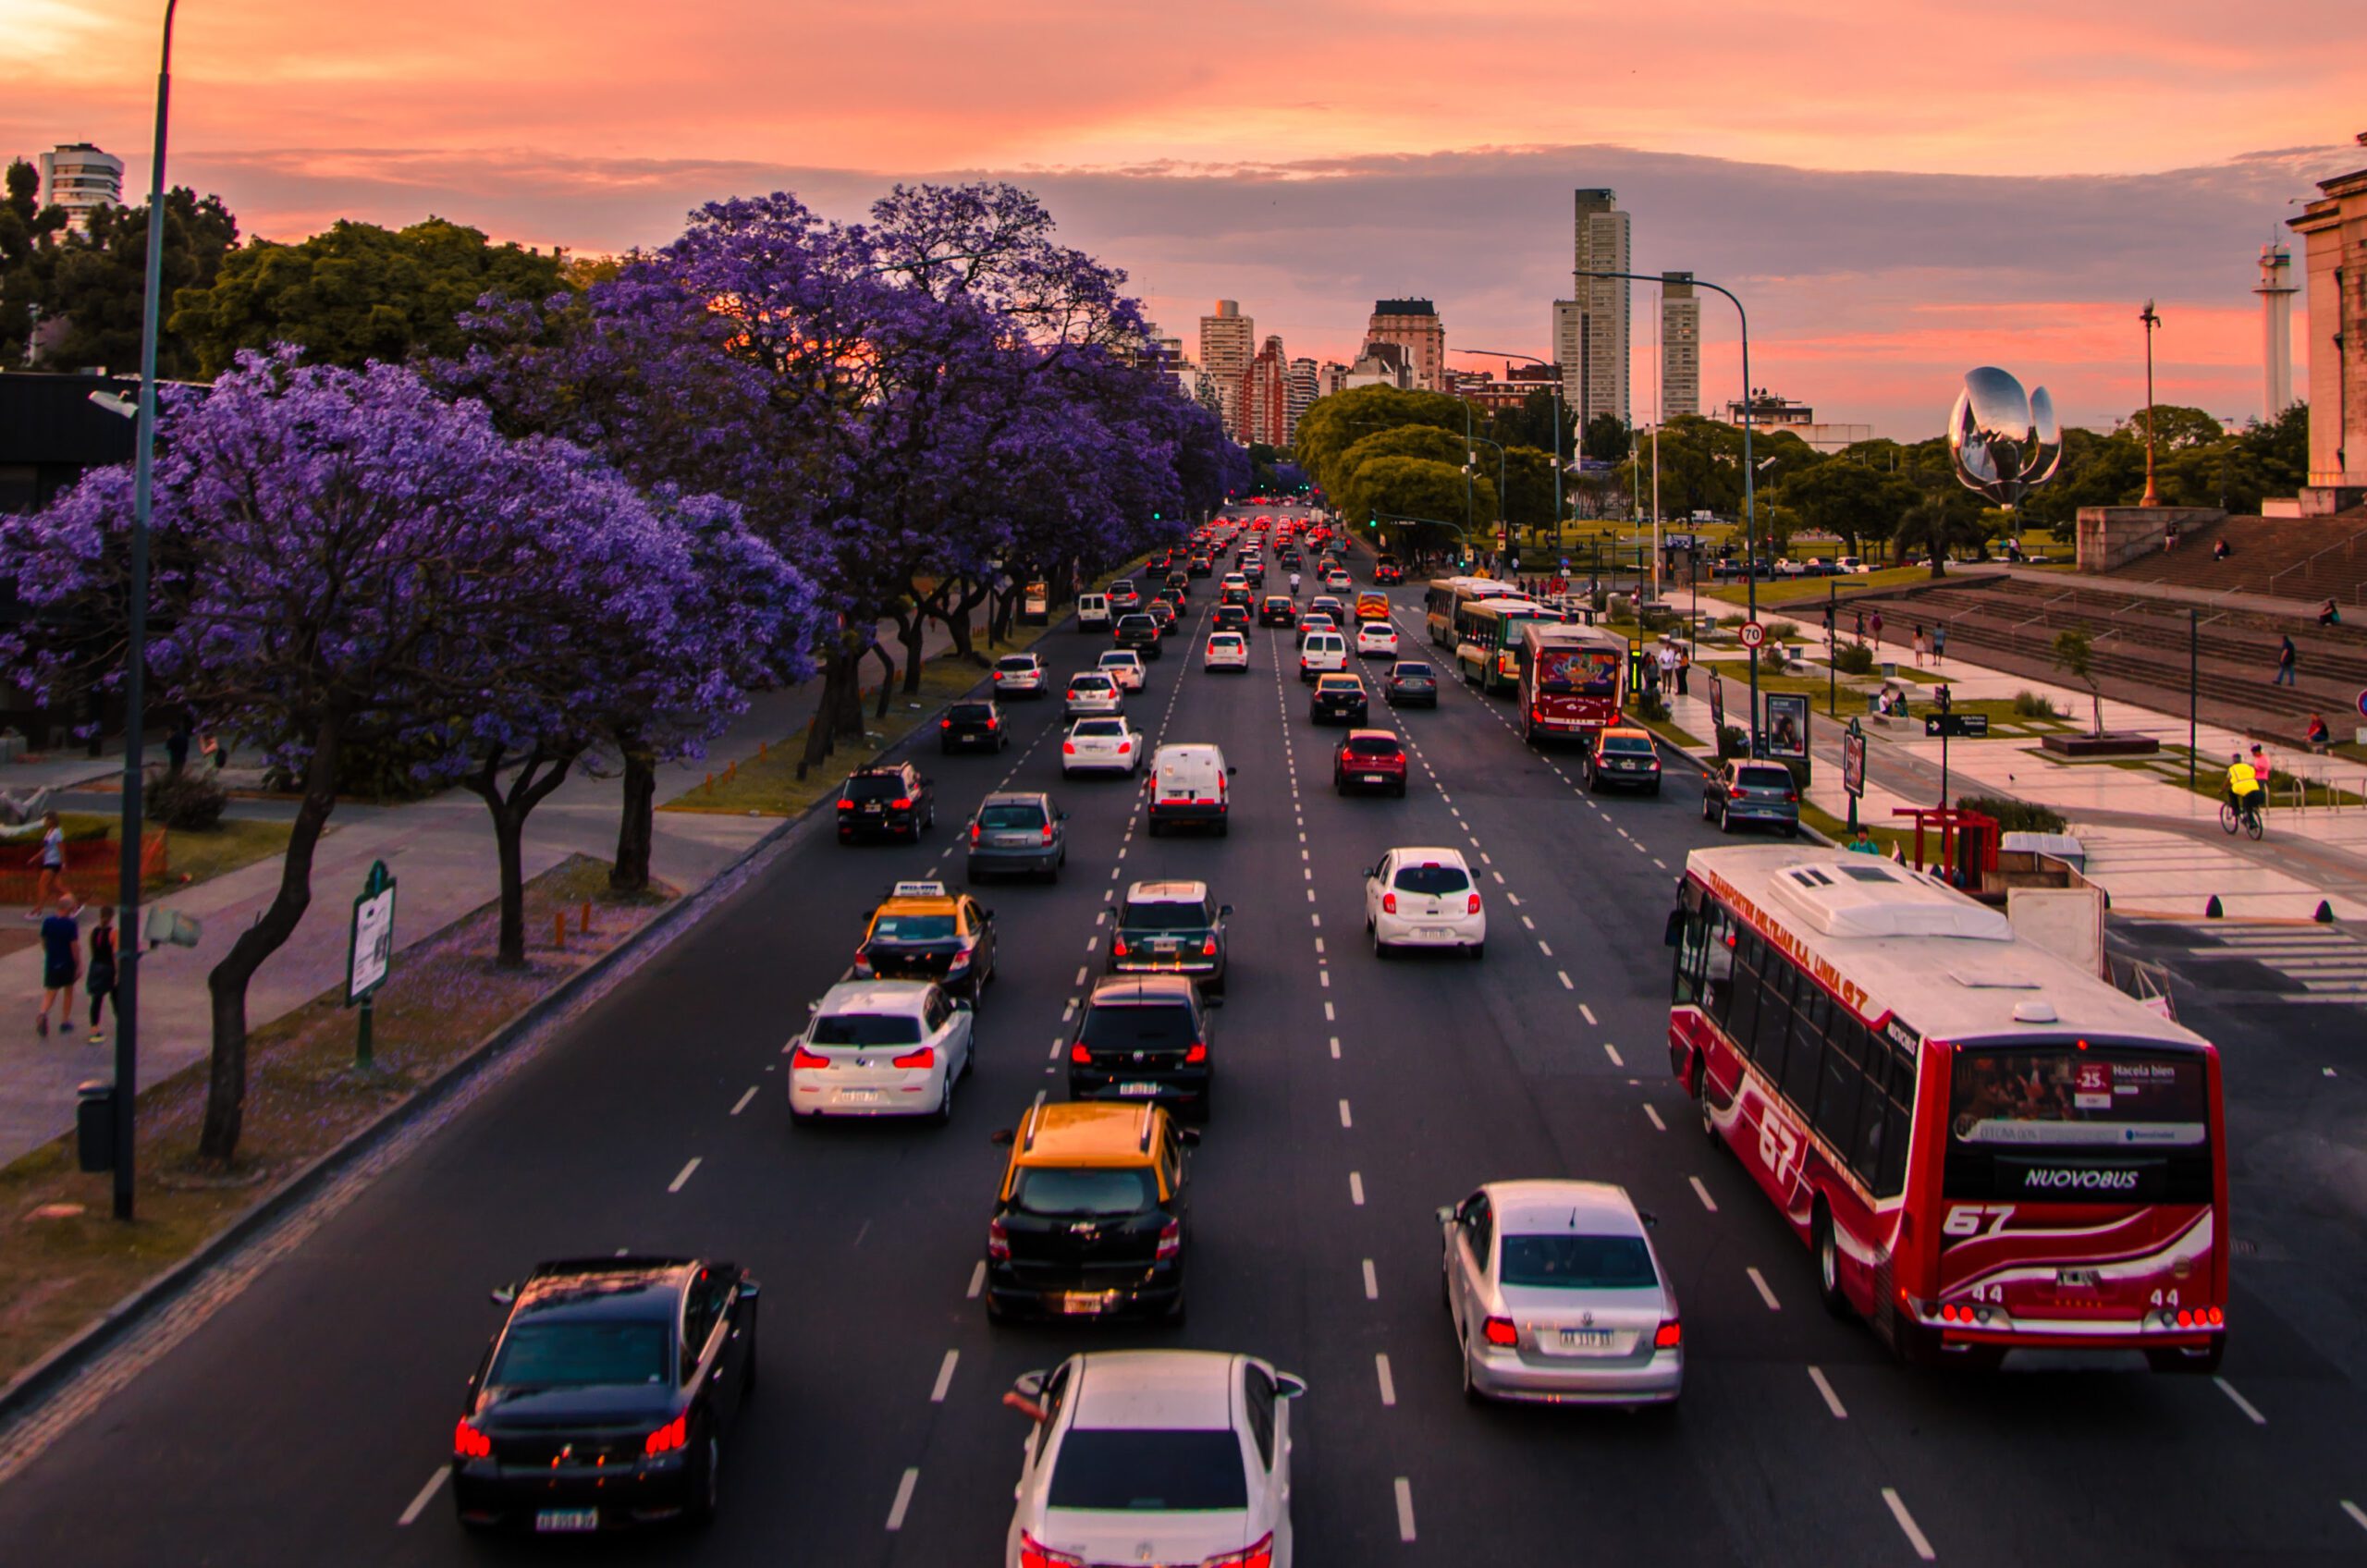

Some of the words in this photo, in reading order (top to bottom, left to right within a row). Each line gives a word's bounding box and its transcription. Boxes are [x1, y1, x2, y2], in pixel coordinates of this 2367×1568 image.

[1745, 629, 1760, 641] 70
[1566, 704, 1588, 712] 67
[1843, 979, 1869, 1012] 67
[1759, 1107, 1797, 1185] 67
[2025, 1169, 2139, 1189] NUOVOBUS
[1943, 1205, 2016, 1236] 67
